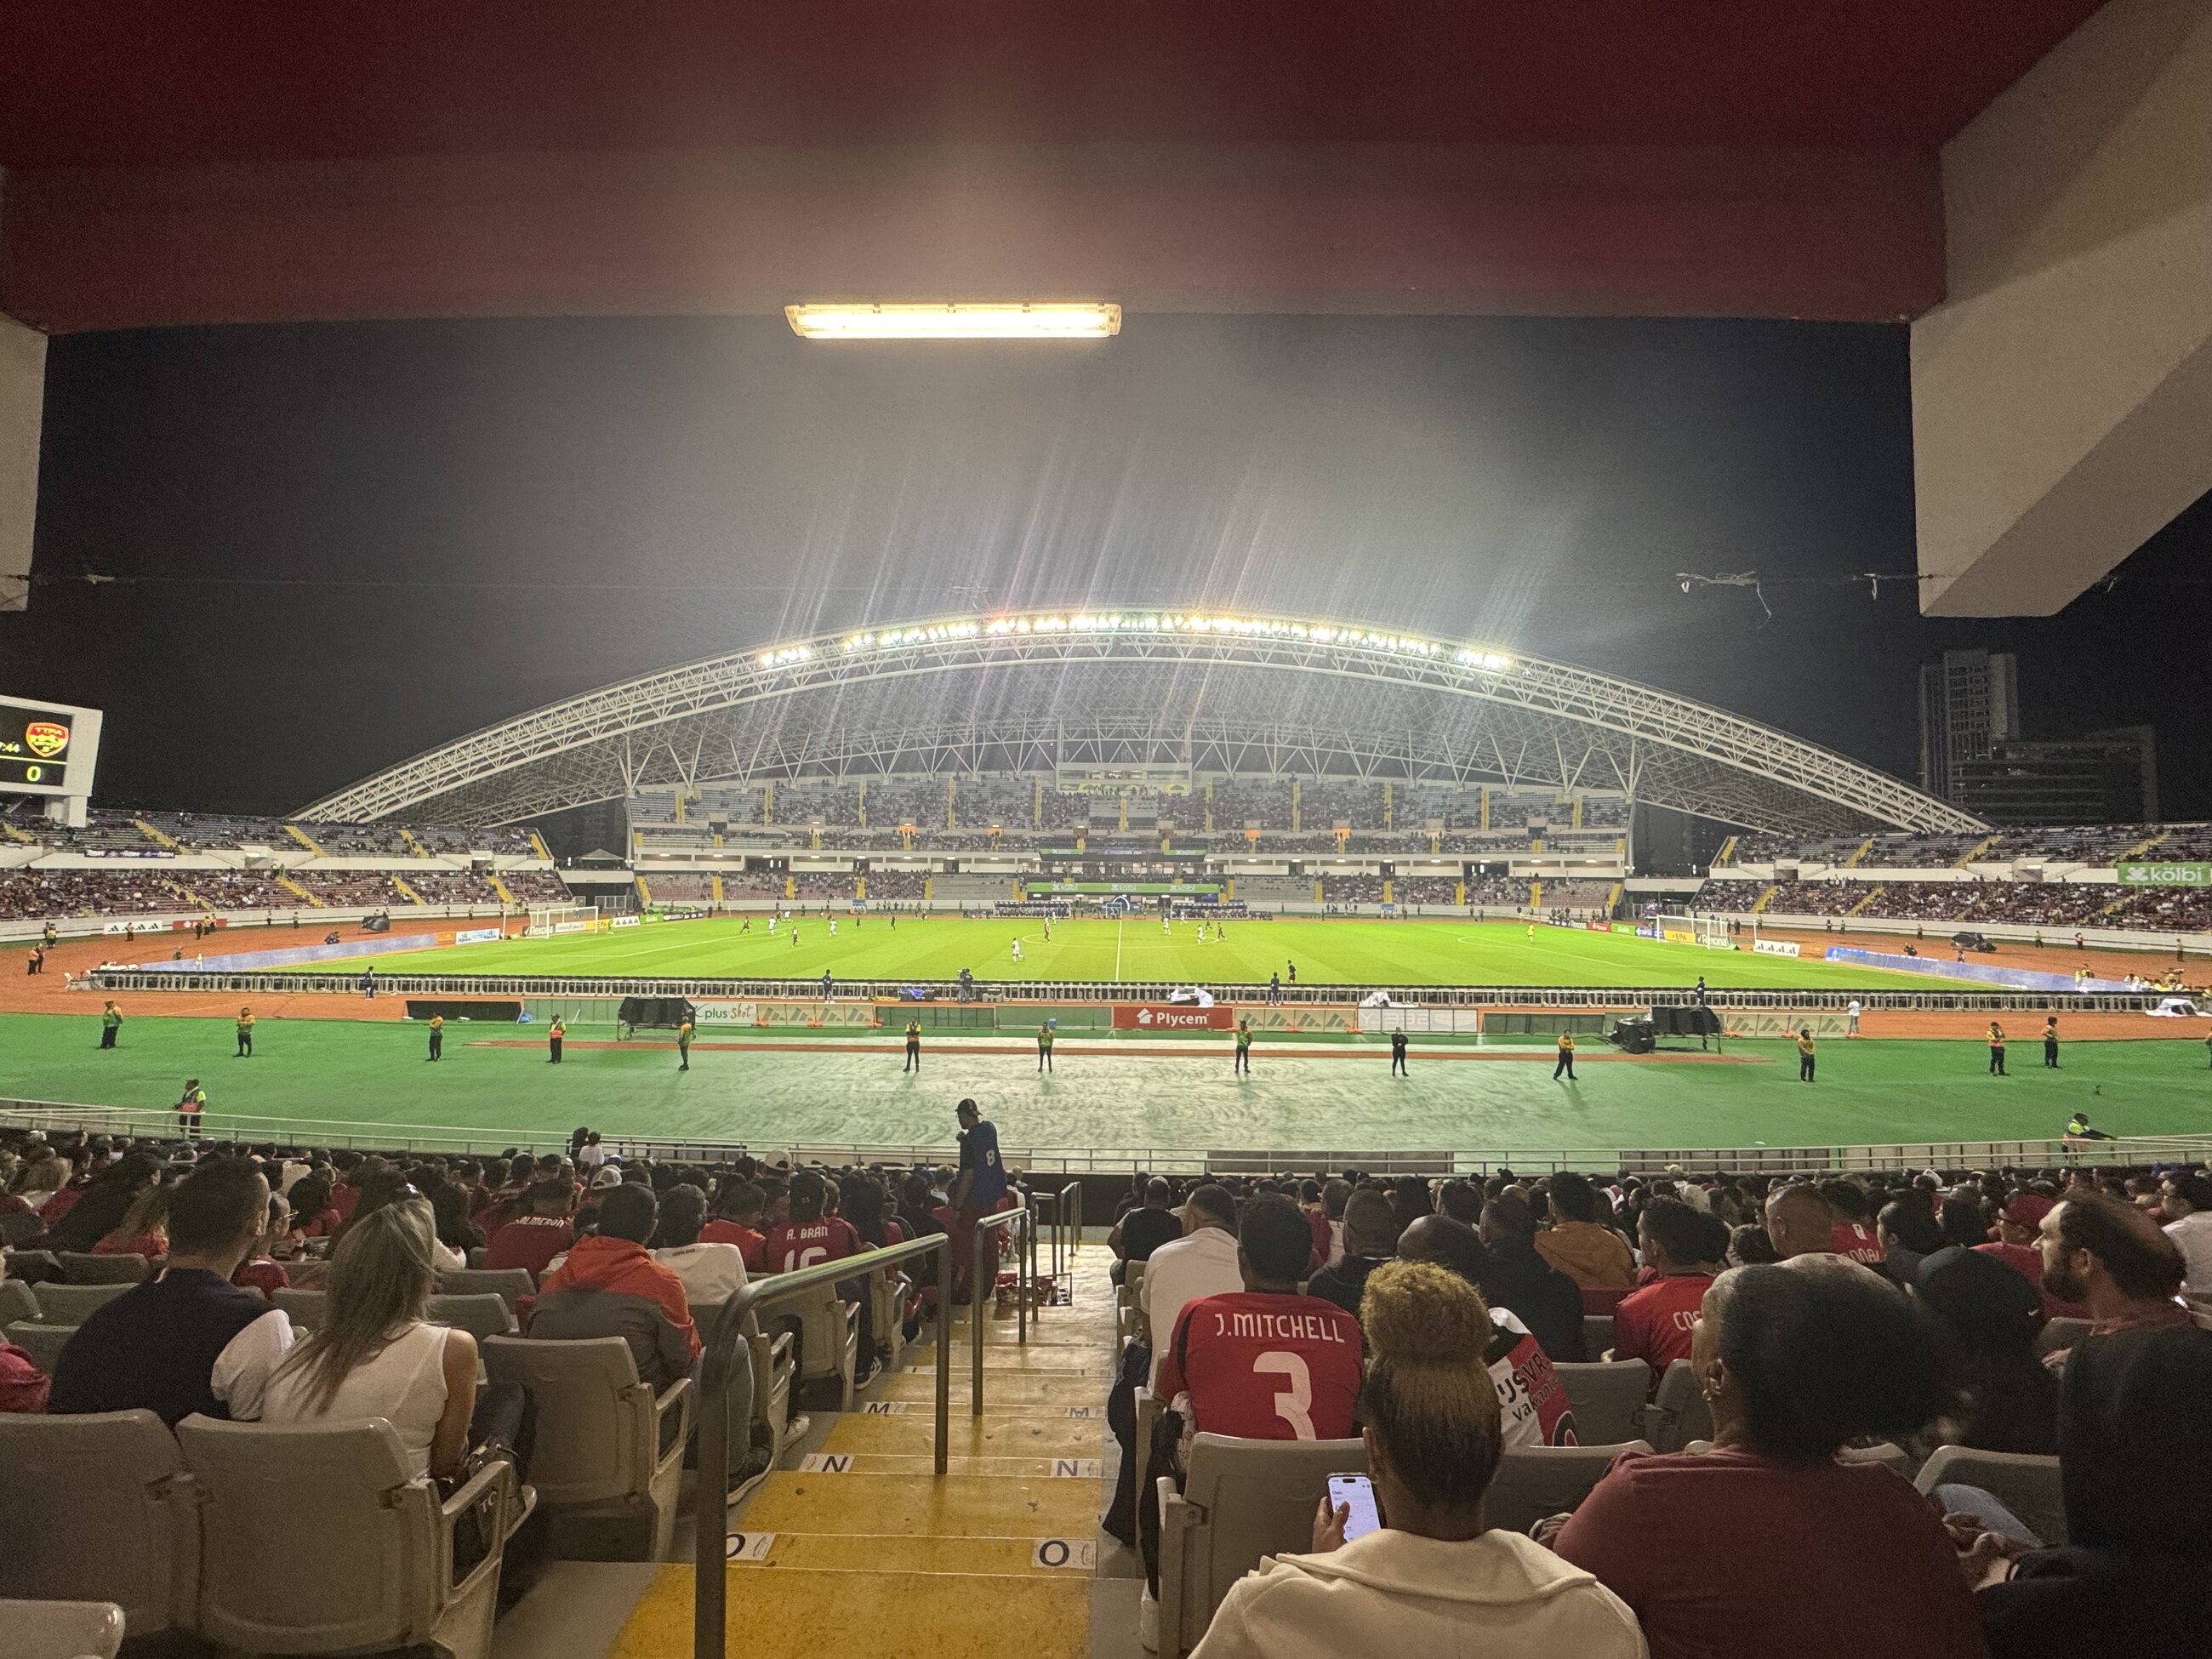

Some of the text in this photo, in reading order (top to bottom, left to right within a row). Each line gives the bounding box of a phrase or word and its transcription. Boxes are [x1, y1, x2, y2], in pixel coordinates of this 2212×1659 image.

[26, 766, 41, 782] 0
[2151, 867, 2202, 881] kölbi
[705, 1008, 727, 1020] plus
[1157, 1012, 1207, 1027] Plycem
[986, 1149, 995, 1166] 8
[801, 1226, 828, 1239] BRAN
[1215, 1313, 1345, 1343] J.MITCHELL
[1253, 1351, 1316, 1440] 3
[822, 1456, 848, 1472] N
[1057, 1460, 1078, 1476] N
[1039, 1540, 1069, 1567] O
